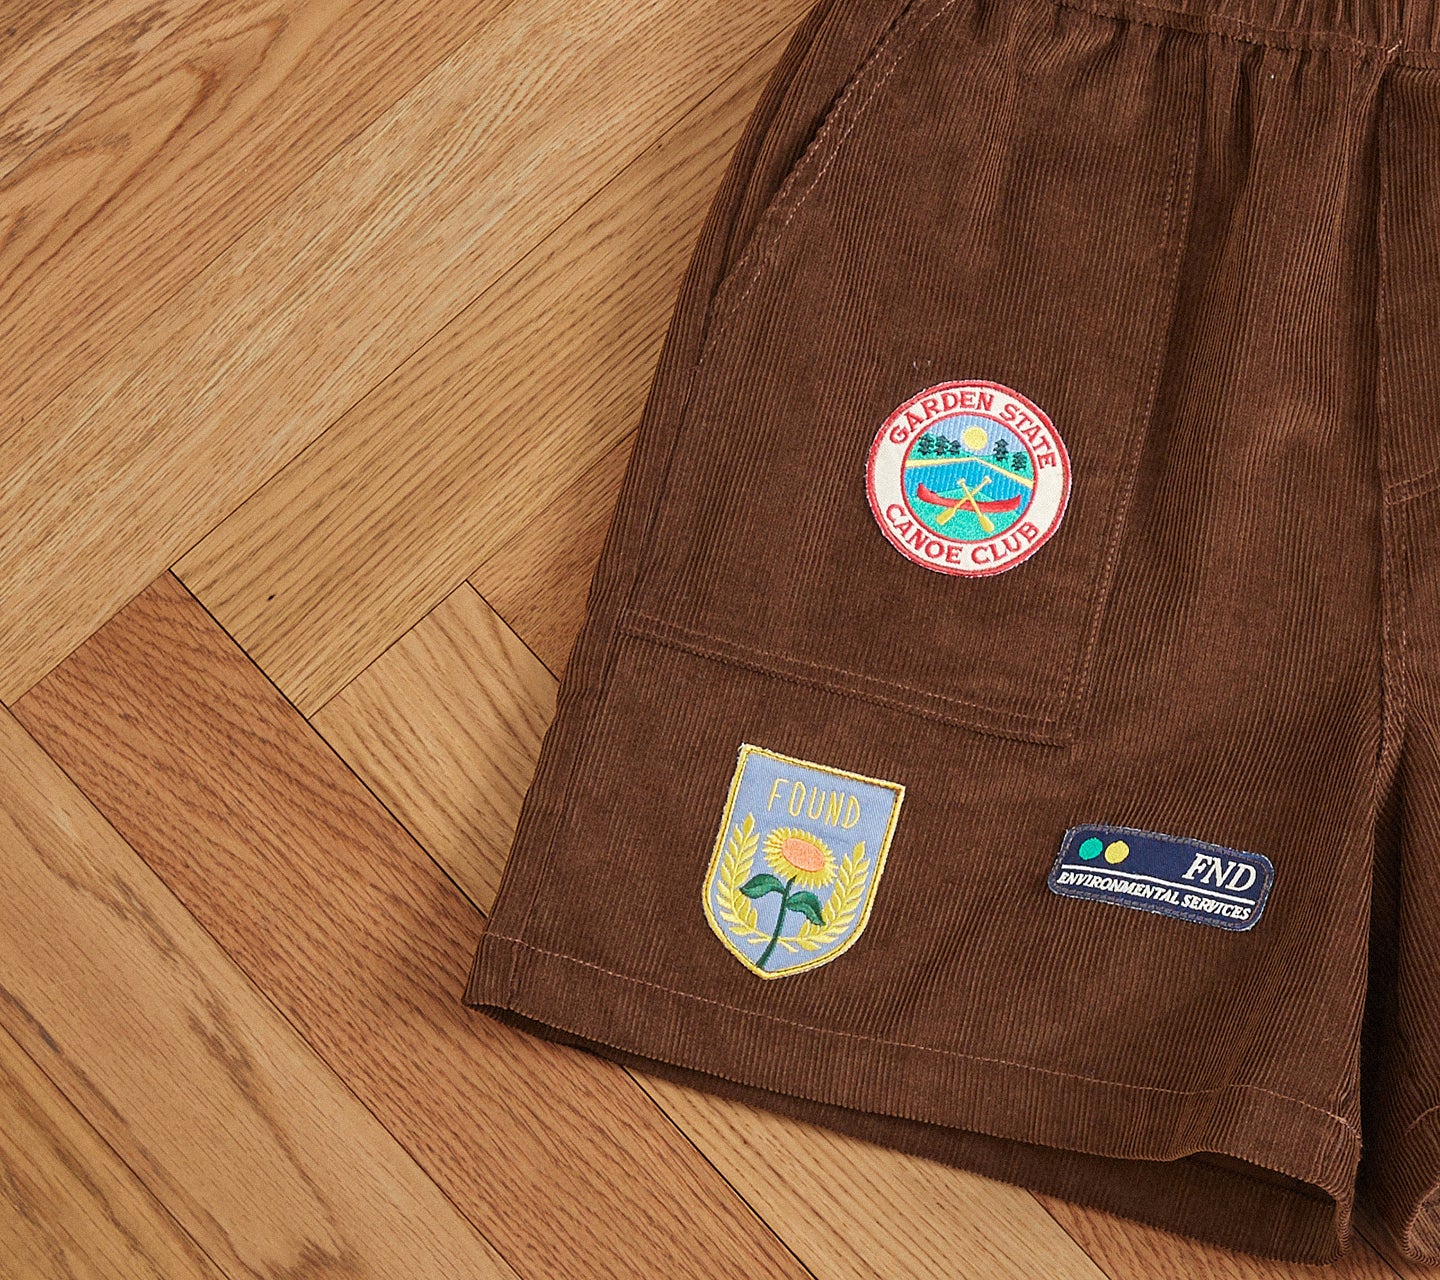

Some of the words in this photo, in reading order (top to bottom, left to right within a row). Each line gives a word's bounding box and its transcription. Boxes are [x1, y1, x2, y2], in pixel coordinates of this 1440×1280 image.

[889, 391, 994, 444] GARDEN
[999, 403, 1057, 470] STATE
[886, 503, 963, 564] CANOE
[971, 521, 1039, 565] CLUB
[766, 778, 860, 829] FOUND
[1057, 872, 1179, 905] ENVIRONMENTAL
[1181, 894, 1252, 921] SERVICES
[1182, 853, 1257, 892] FND
